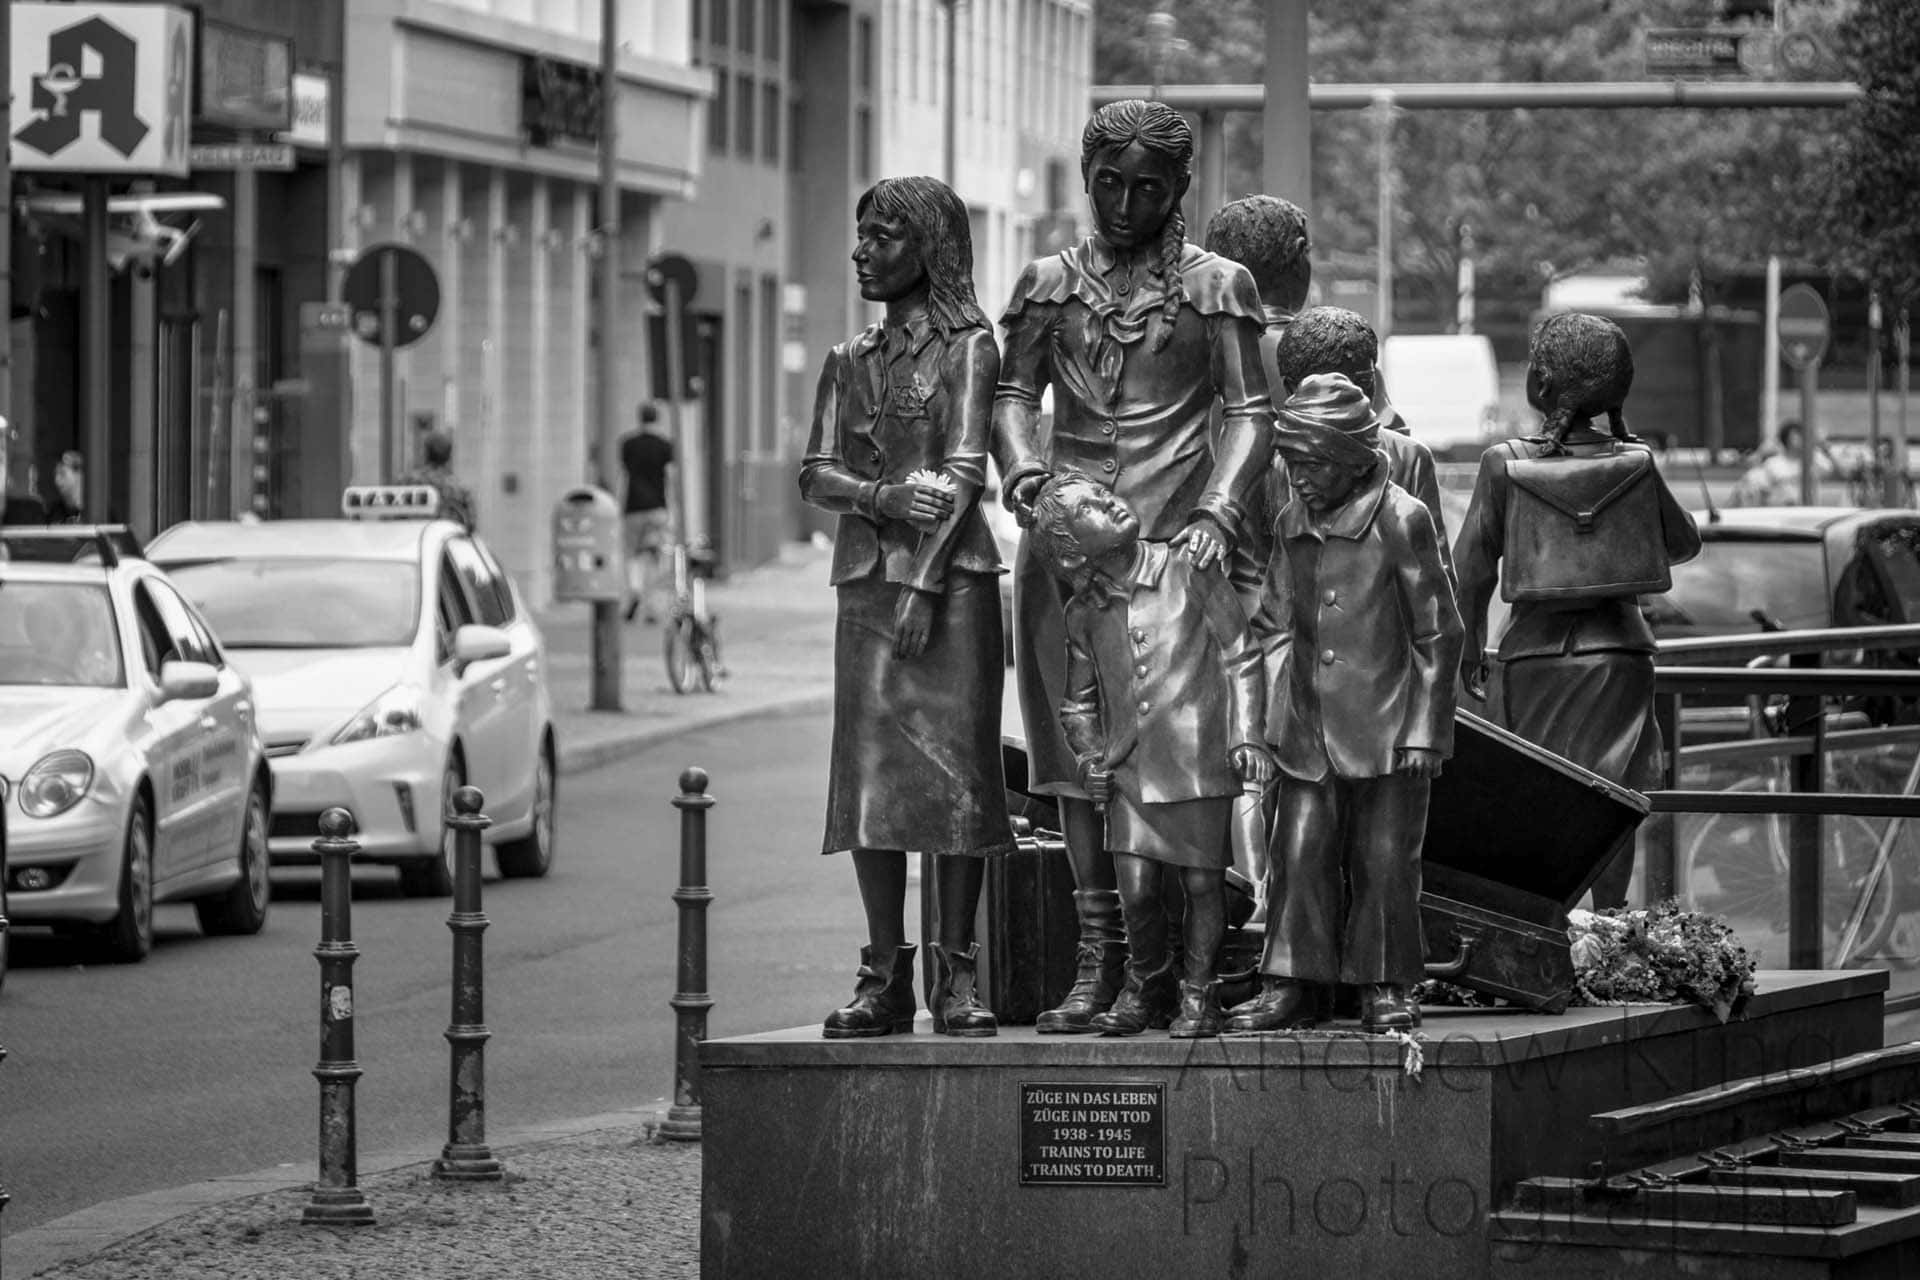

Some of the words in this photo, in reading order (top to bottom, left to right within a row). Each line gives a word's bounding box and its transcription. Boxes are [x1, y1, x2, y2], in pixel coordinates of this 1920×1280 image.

[1026, 1089, 1063, 1104] ZÜGE
[1065, 1092, 1080, 1104] IN
[1083, 1092, 1111, 1104] DAS
[1112, 1092, 1157, 1105] LEBEN
[1032, 1107, 1070, 1122] ZÜGE
[1072, 1110, 1087, 1122] IN
[1089, 1110, 1118, 1122] DEN
[1120, 1110, 1151, 1123] TOD
[1053, 1128, 1087, 1141] 1938
[1097, 1128, 1132, 1141] 1945
[1040, 1146, 1091, 1158] TRAINS
[1092, 1146, 1113, 1159] TO
[1115, 1146, 1146, 1159] LIFE
[1030, 1164, 1082, 1176] TRAINS
[1083, 1164, 1104, 1177] TO
[1106, 1164, 1154, 1177] DEATH
